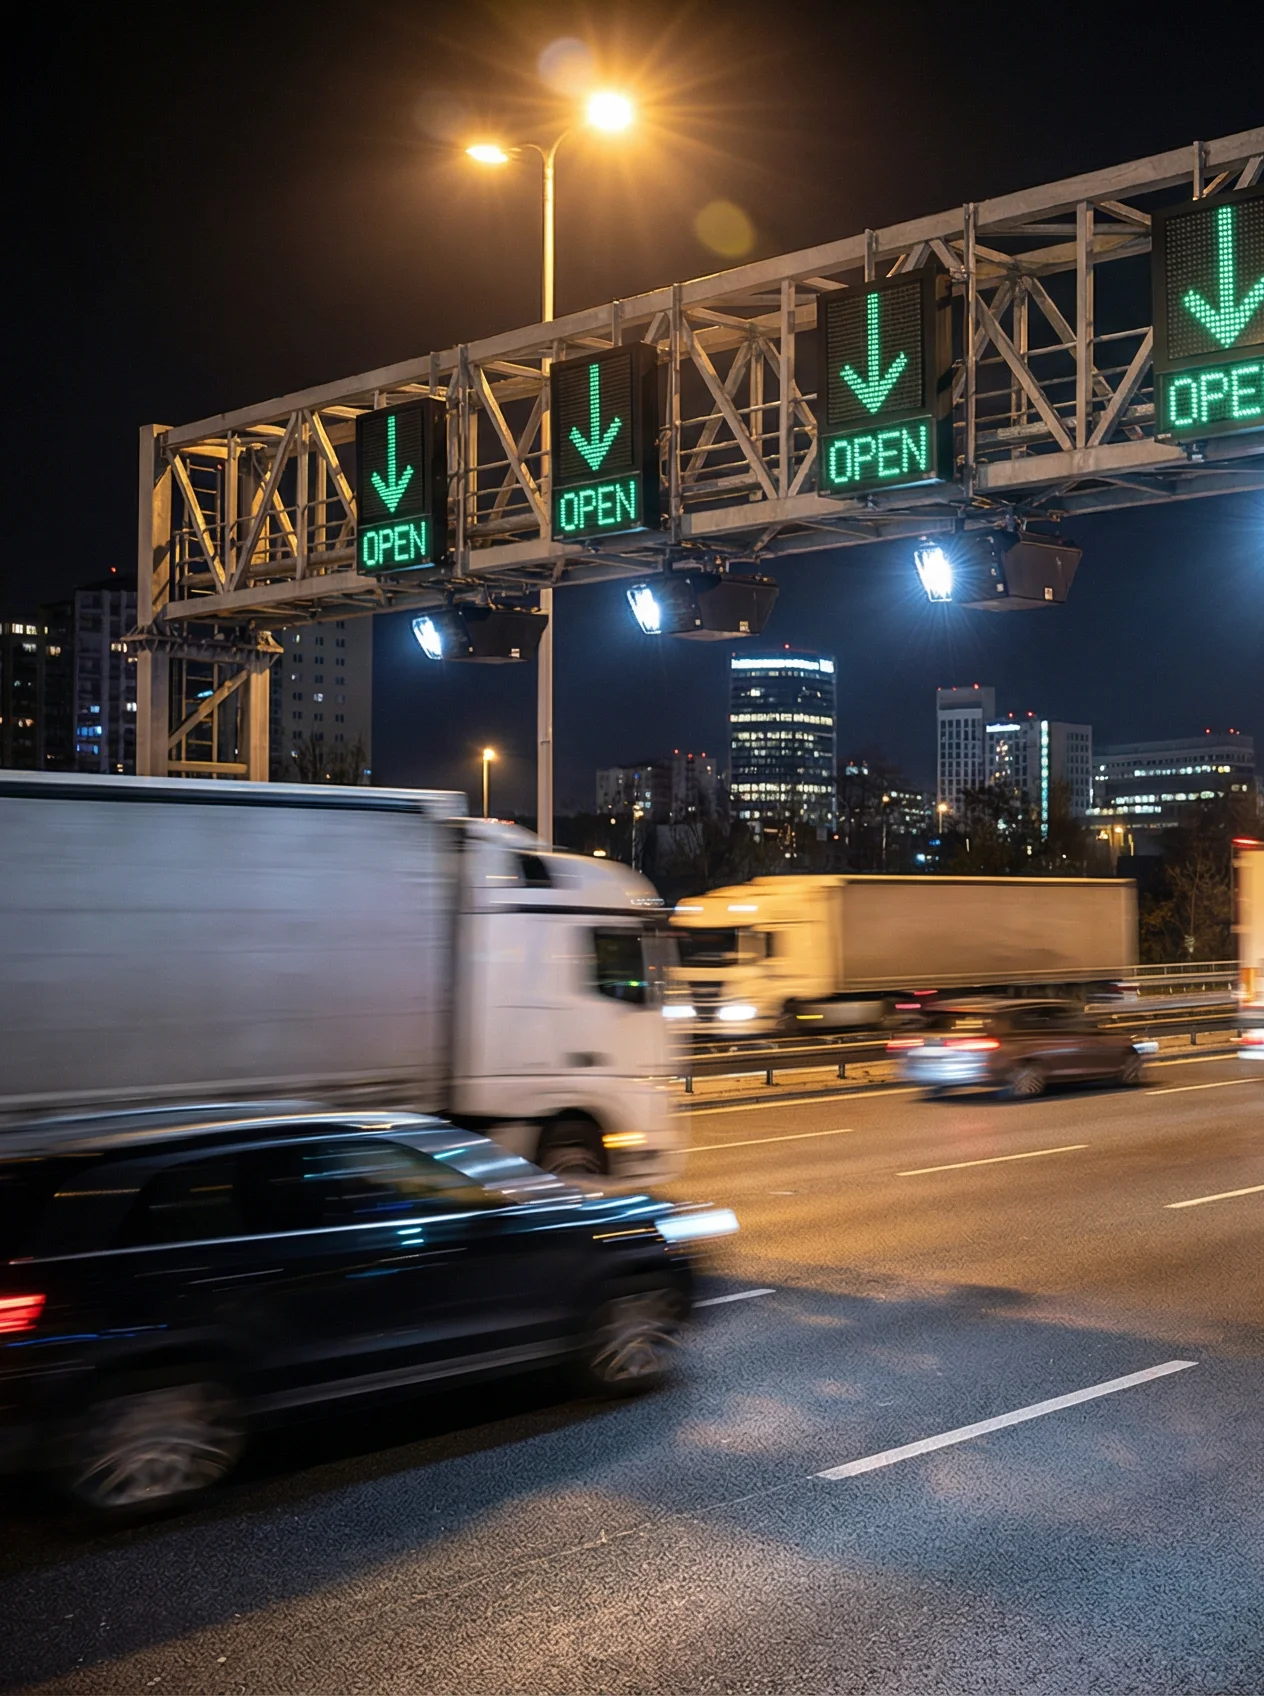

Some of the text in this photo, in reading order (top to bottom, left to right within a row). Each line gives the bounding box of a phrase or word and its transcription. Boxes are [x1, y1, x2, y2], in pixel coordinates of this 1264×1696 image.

[828, 424, 928, 485] OPEN
[559, 480, 636, 533] OPEN
[362, 521, 427, 568] OPEN
